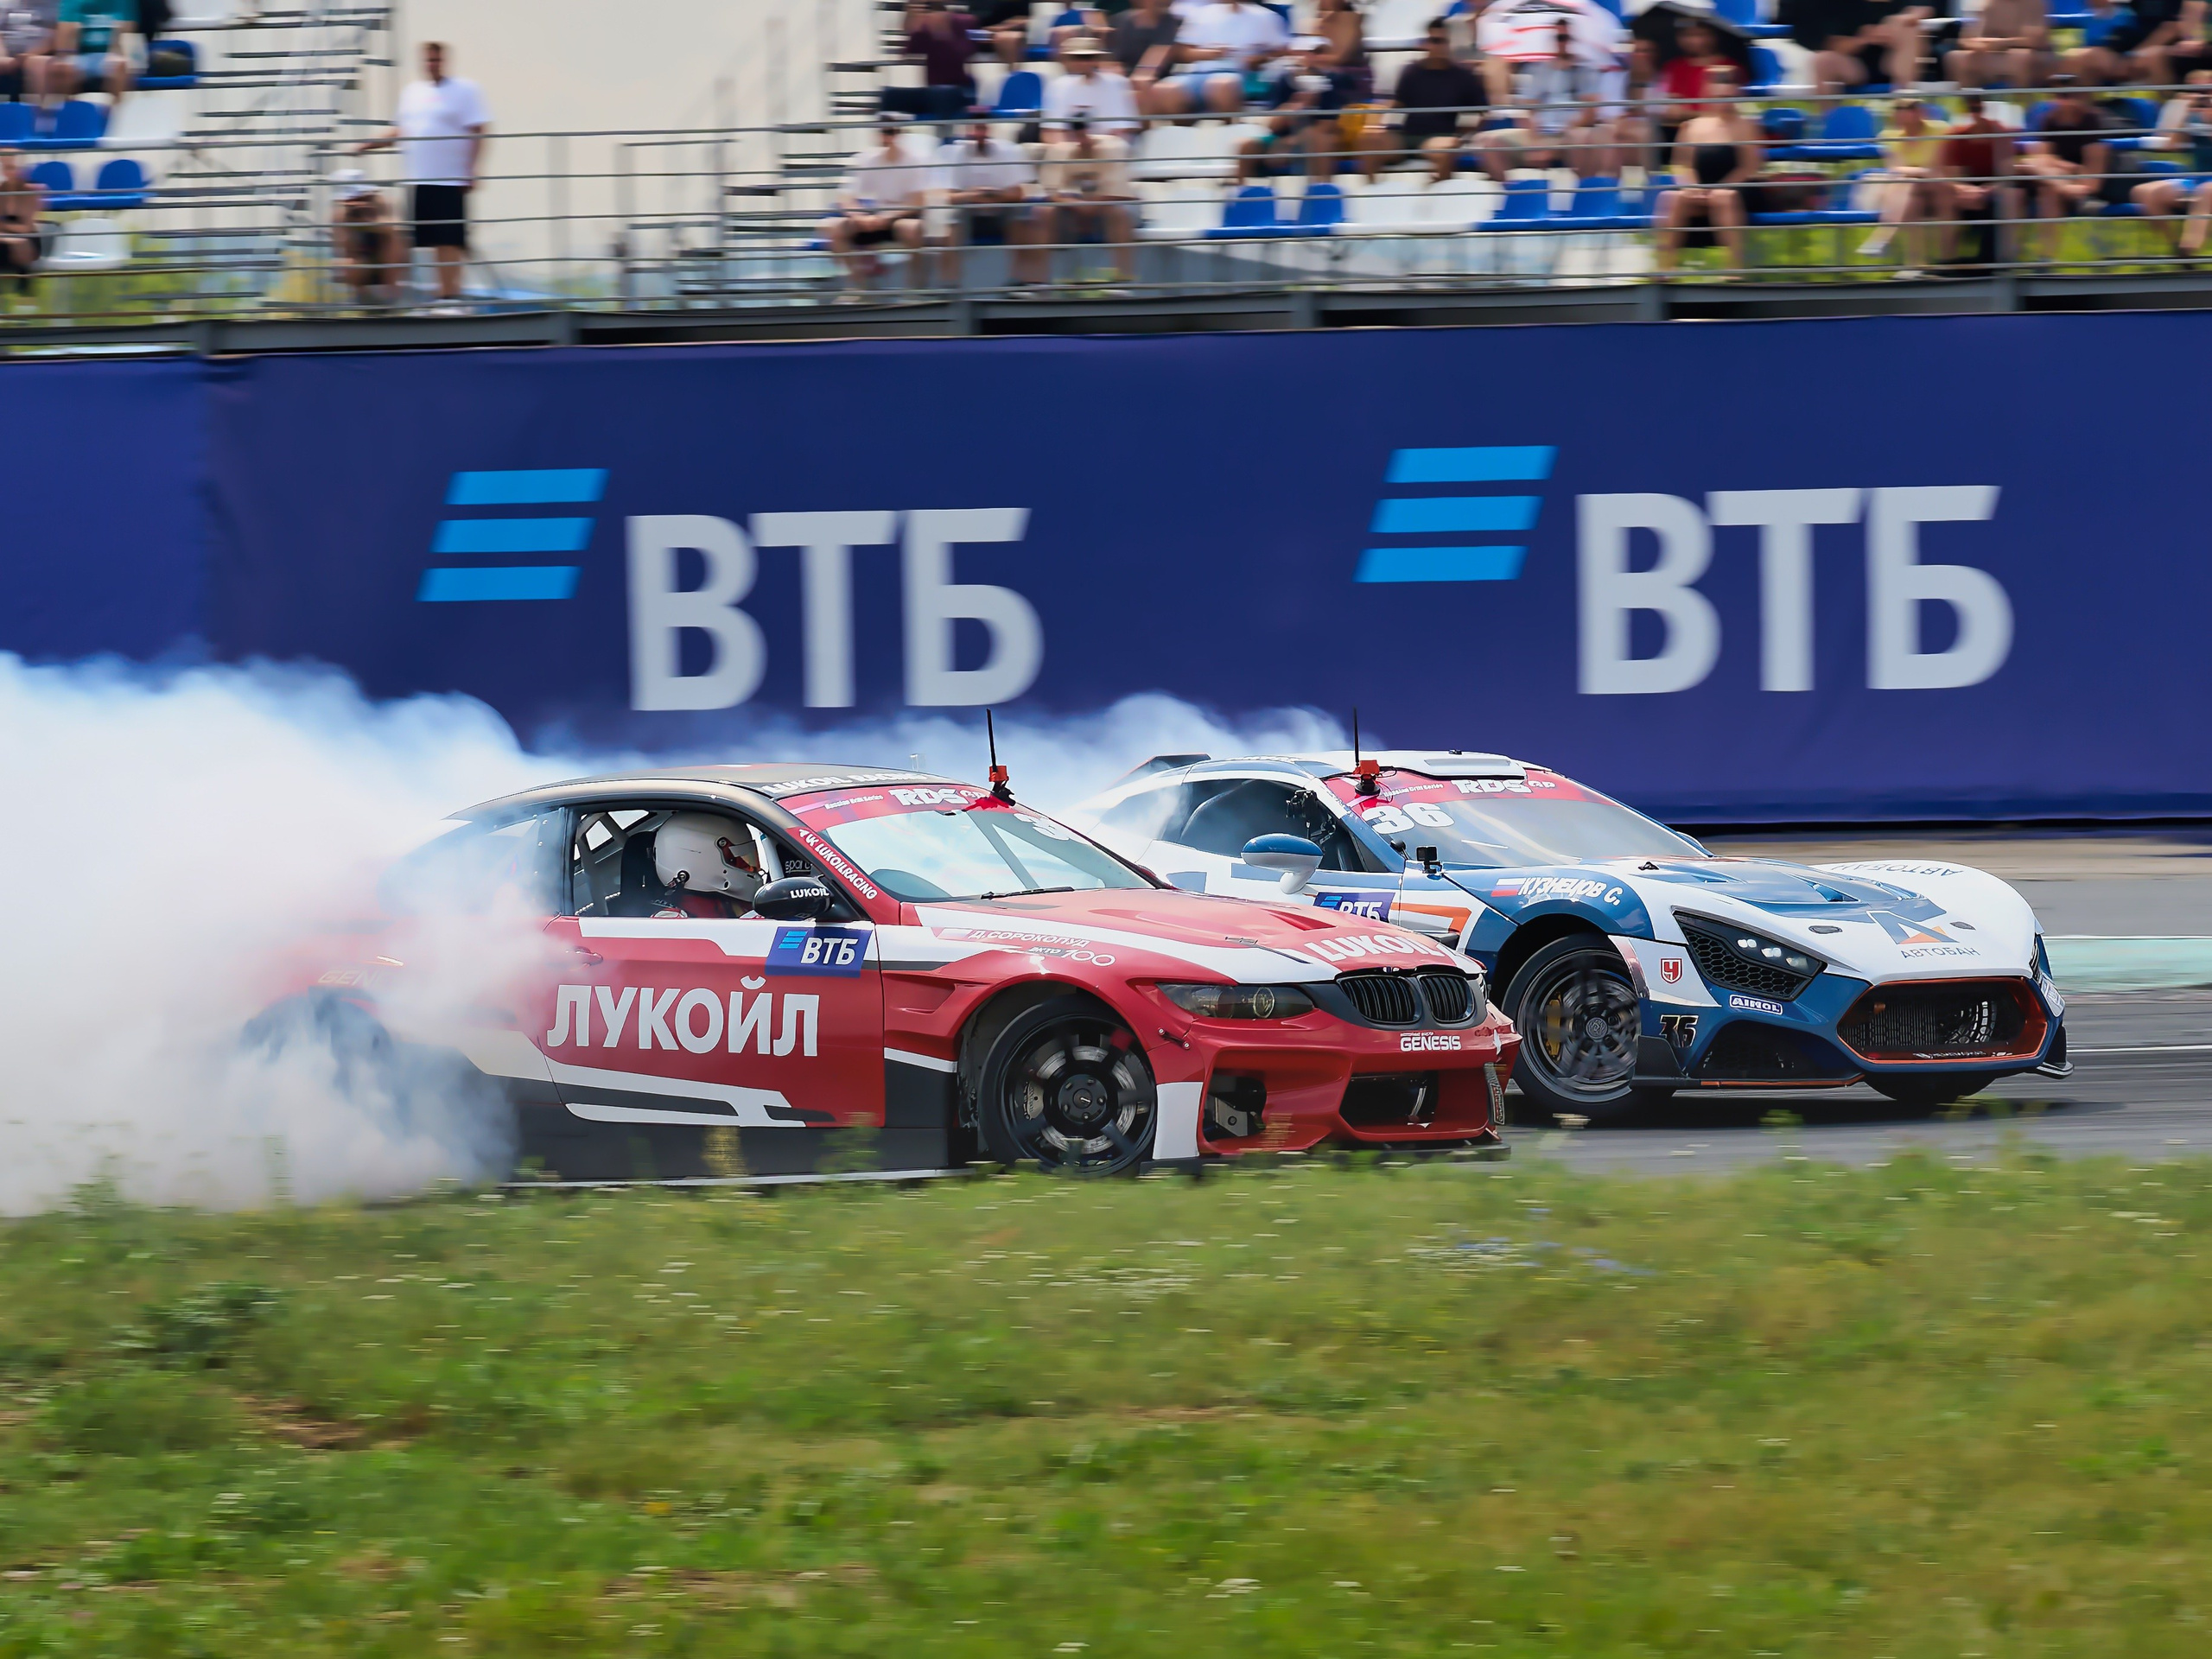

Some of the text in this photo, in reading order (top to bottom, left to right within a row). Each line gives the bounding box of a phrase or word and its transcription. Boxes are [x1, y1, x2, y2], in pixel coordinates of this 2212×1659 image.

[1575, 485, 2014, 694] ВТБ
[625, 508, 1045, 711] ВТБ
[1451, 779, 1533, 794] RDS
[888, 789, 969, 806] RDS
[1361, 803, 1455, 835] 36
[790, 888, 830, 899] LUKOIL
[1518, 877, 1607, 898] КУЗНЕЦОВ
[800, 937, 859, 966] ВТБ
[1061, 949, 1116, 967] 100
[1304, 935, 1446, 963] LUKOIL
[1901, 947, 1980, 959] АВТОБАН
[546, 975, 820, 1058] ЛУКОЙЛ
[1401, 1036, 1462, 1052] GENESIS
